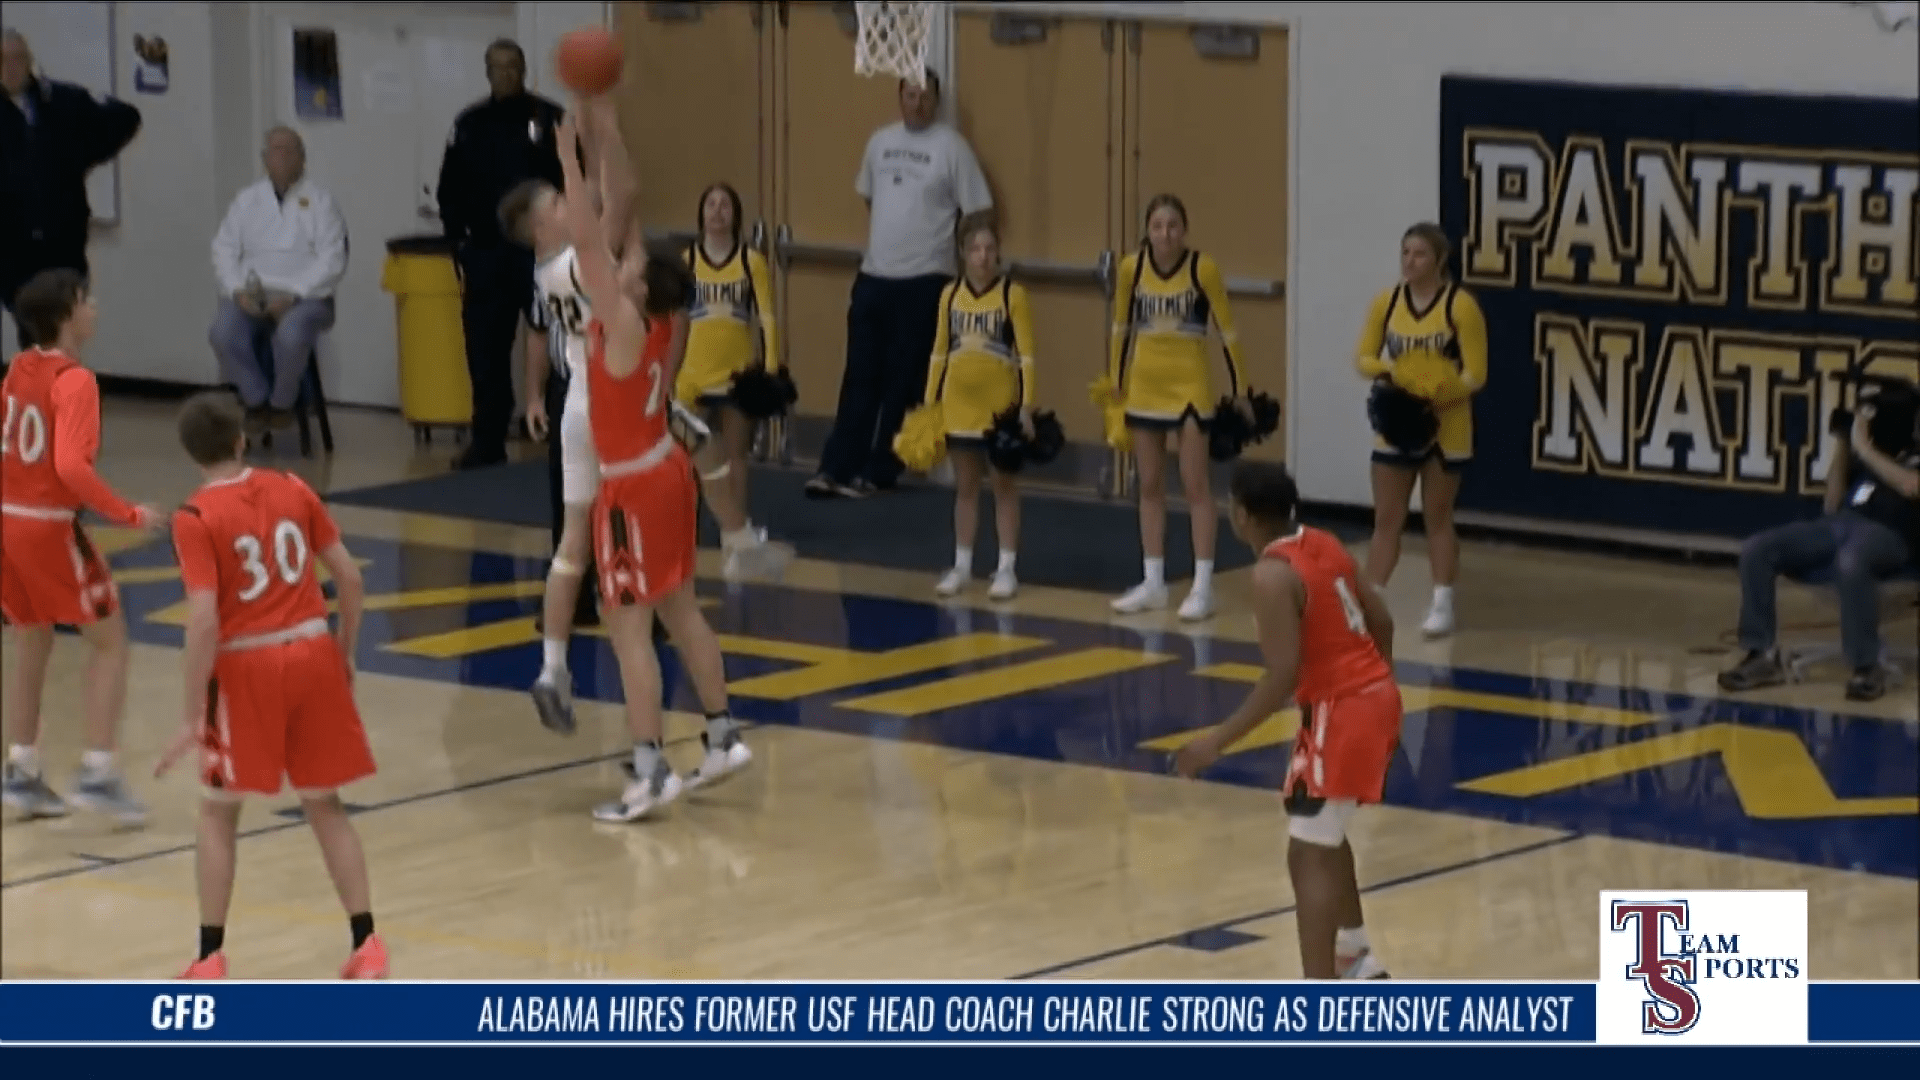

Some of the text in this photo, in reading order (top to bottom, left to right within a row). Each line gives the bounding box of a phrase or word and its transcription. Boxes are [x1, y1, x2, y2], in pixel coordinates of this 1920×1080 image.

[1531, 312, 1918, 495] NATI
[232, 518, 307, 601] 30
[1334, 576, 1366, 635] 4
